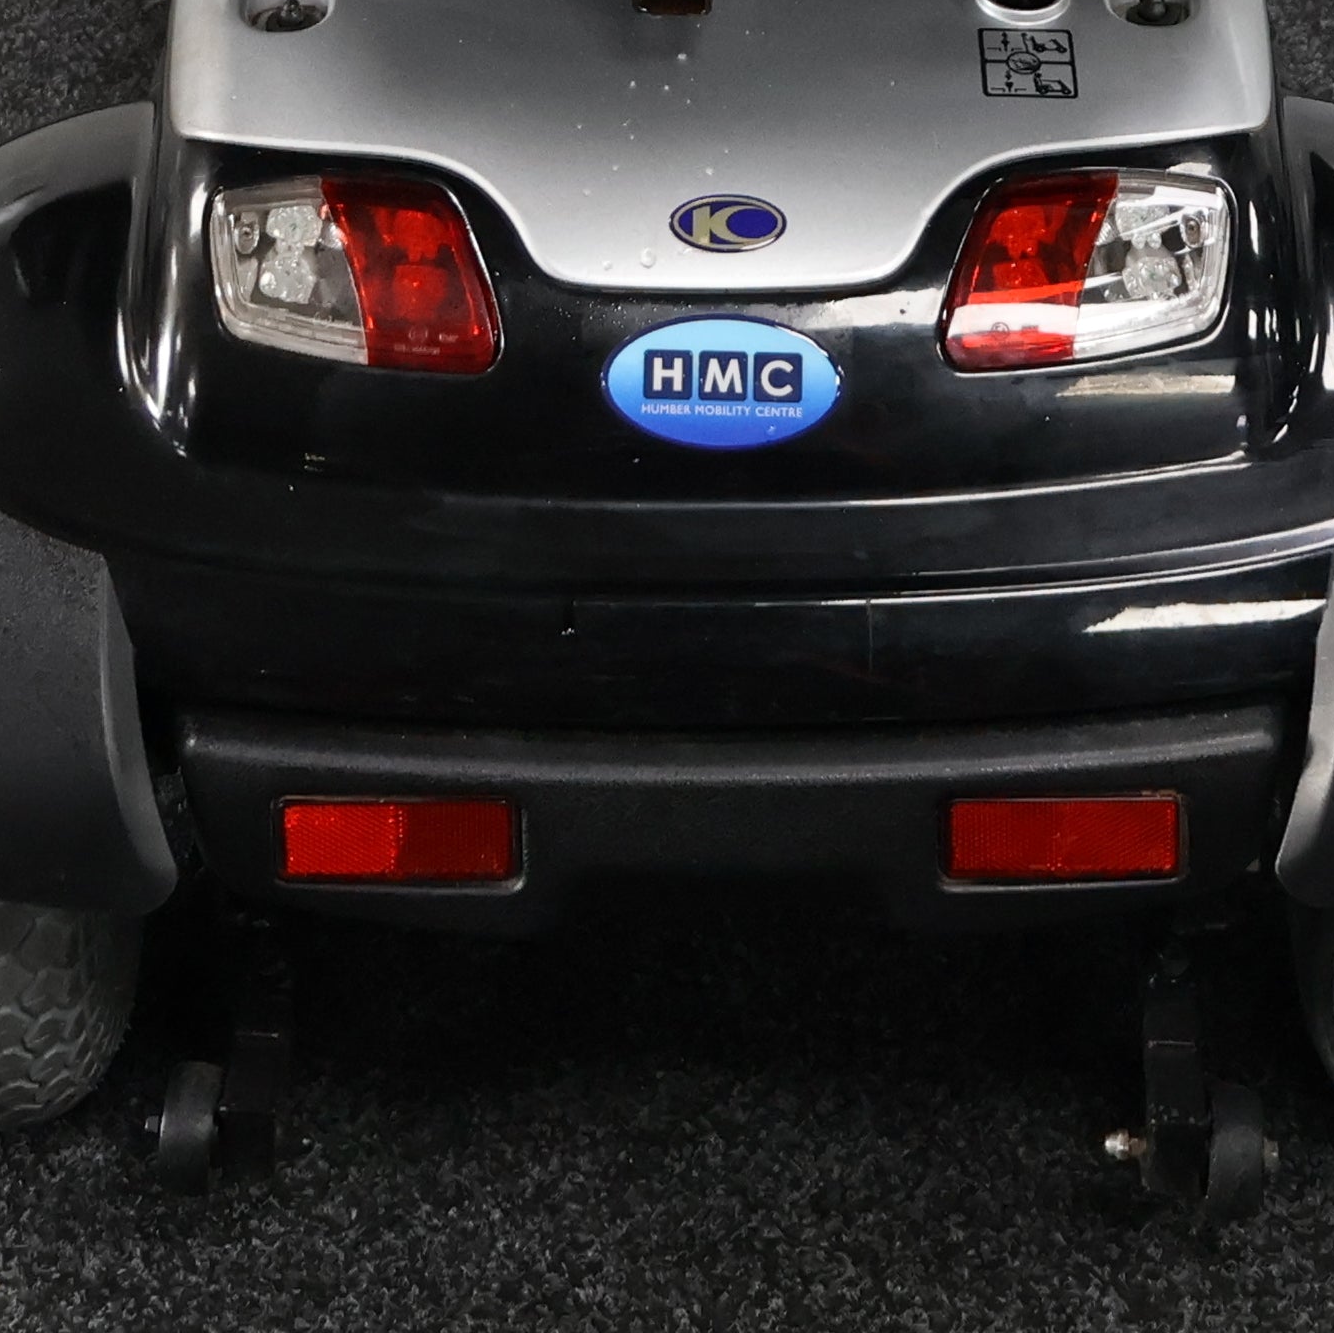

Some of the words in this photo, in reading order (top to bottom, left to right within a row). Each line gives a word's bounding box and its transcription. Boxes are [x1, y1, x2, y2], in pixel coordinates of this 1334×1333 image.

[652, 357, 794, 397] HMC
[641, 404, 691, 415] HUMBER
[695, 405, 751, 417] MOBILITY
[755, 406, 803, 418] CENTRE
